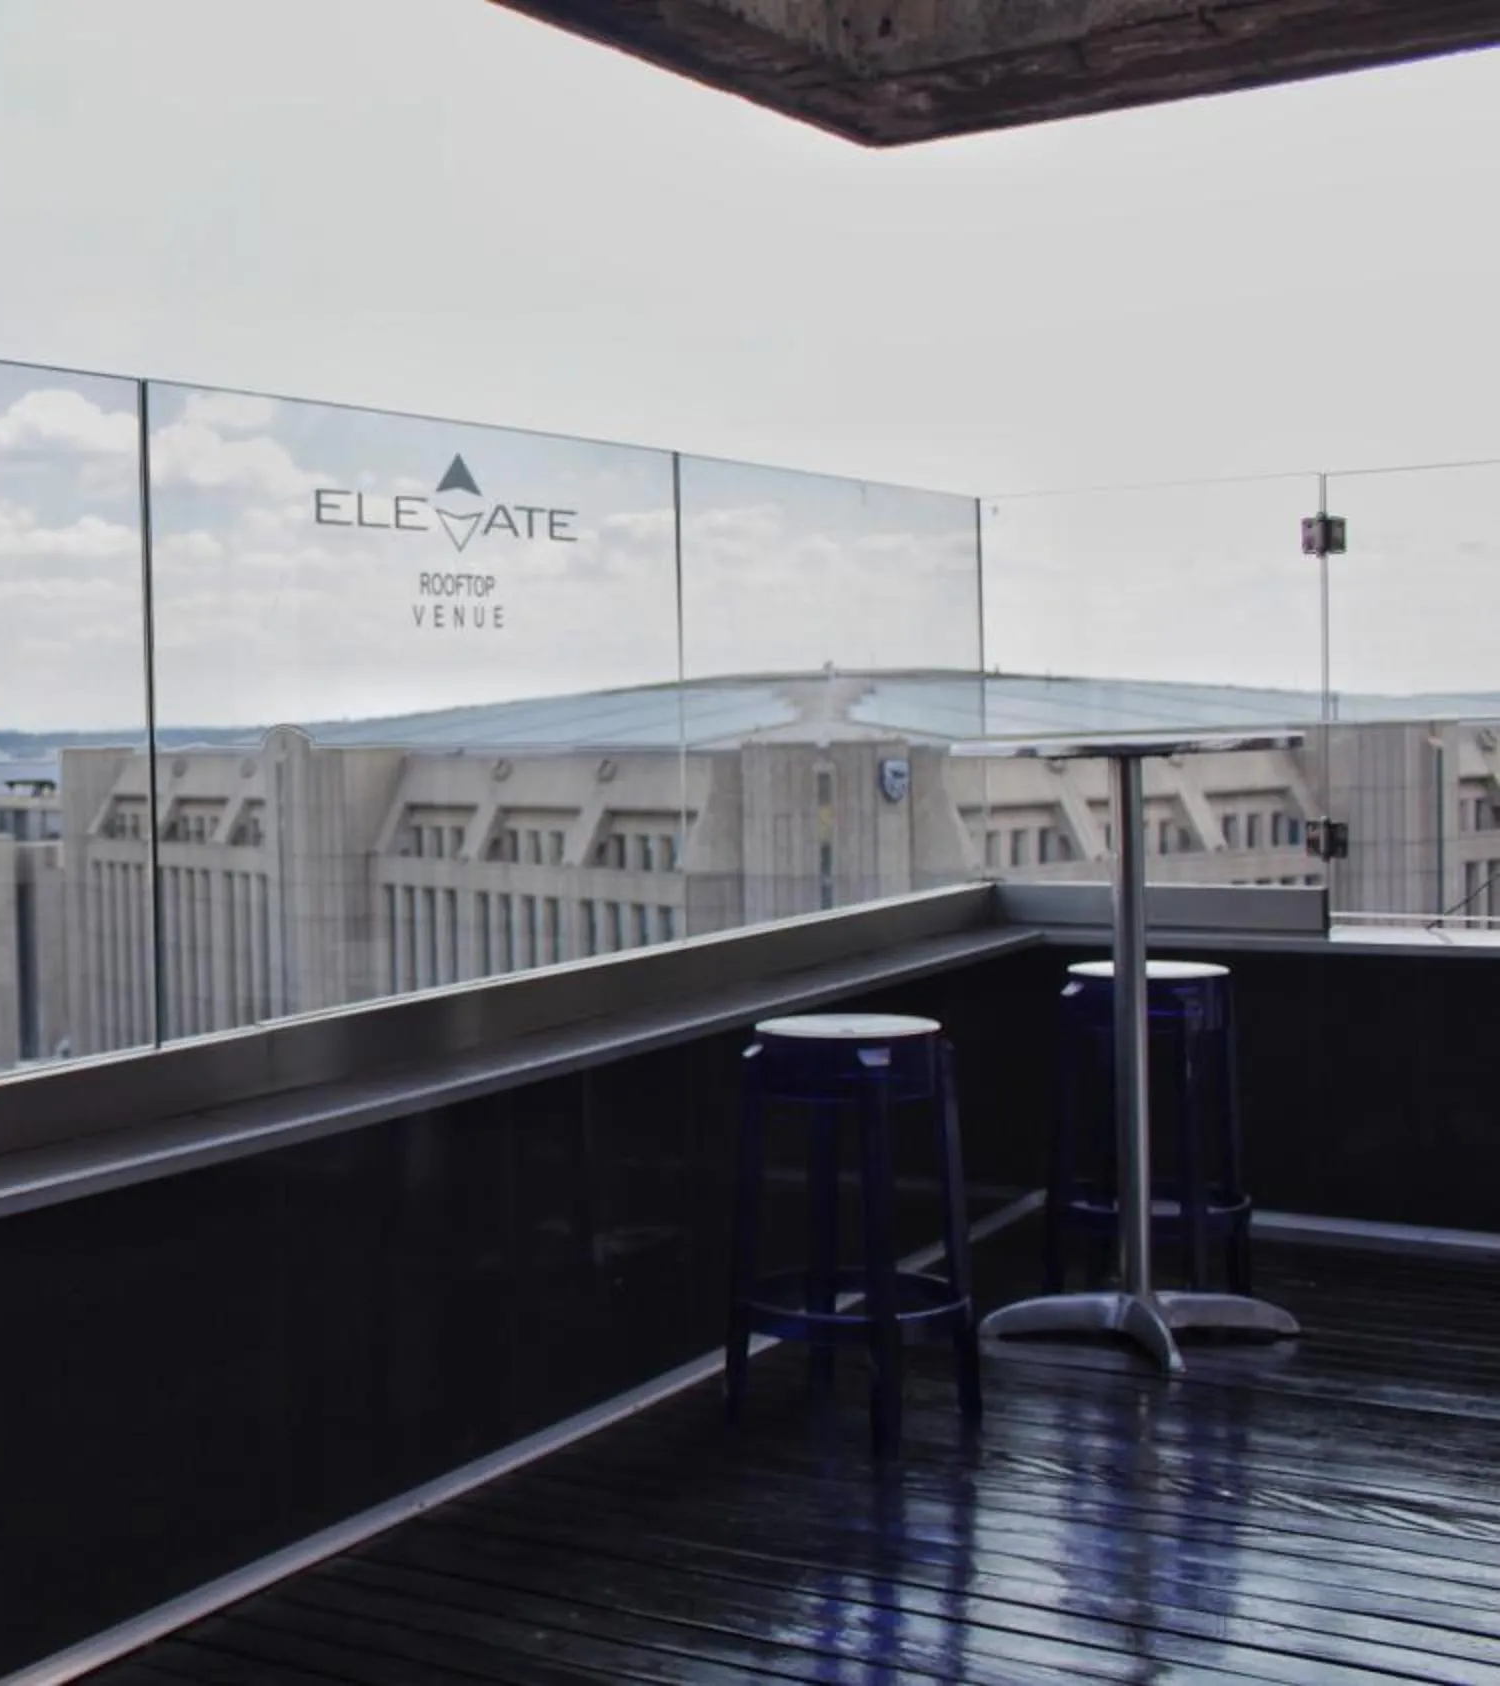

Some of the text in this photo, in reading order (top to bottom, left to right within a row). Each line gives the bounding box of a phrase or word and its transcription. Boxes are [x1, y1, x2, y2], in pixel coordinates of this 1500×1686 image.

[314, 488, 579, 553] ELEVATE
[419, 572, 496, 598] ROOFTOP
[412, 604, 505, 629] VENUE
